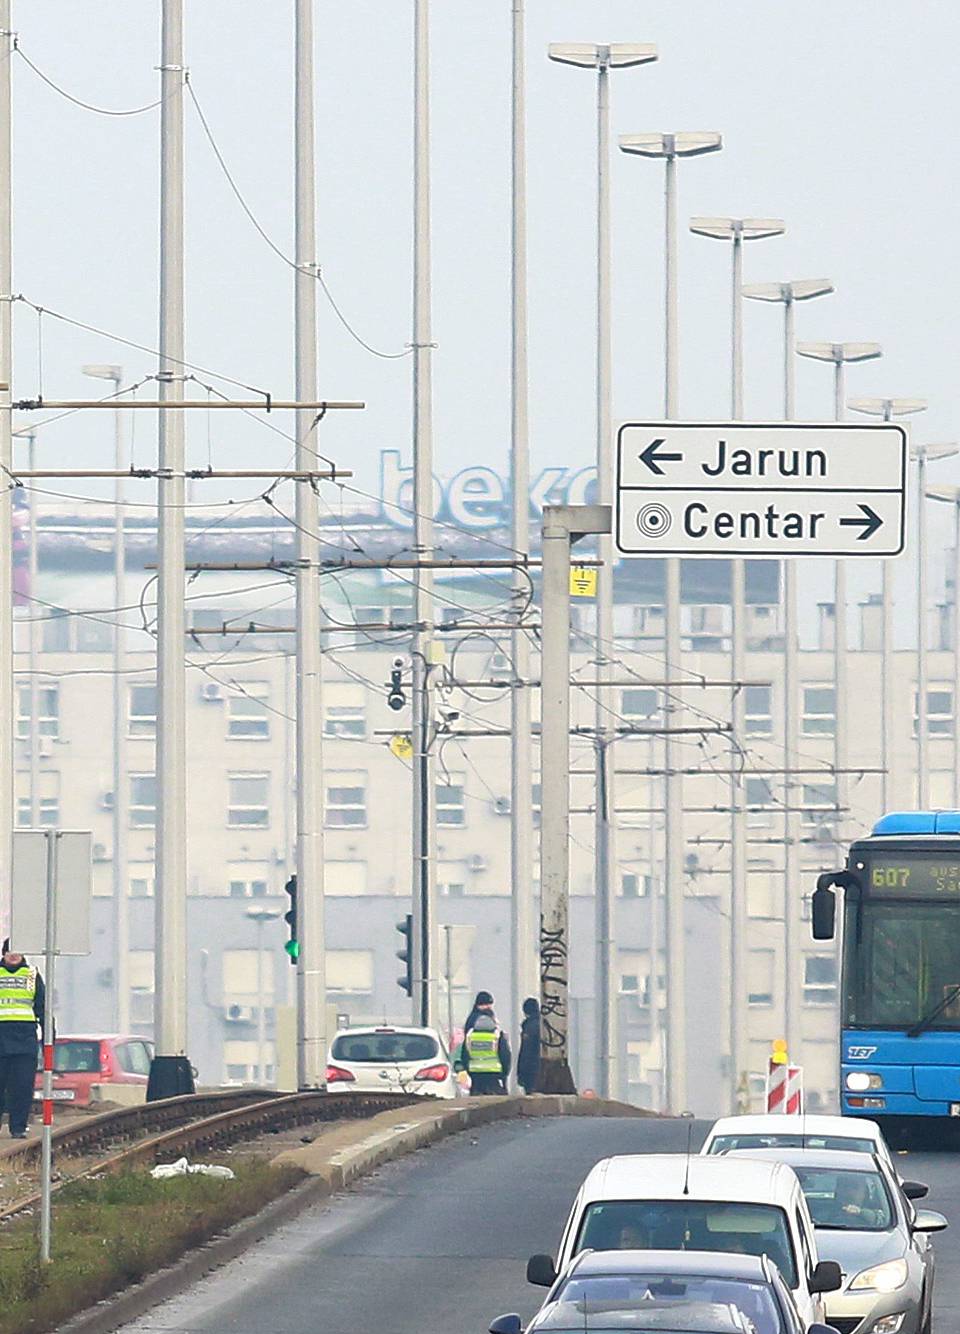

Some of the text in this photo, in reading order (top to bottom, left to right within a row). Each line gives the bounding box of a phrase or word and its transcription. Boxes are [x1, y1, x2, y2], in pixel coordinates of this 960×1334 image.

[701, 441, 826, 476] Jarun
[684, 502, 825, 538] Centar
[872, 867, 911, 888] 607
